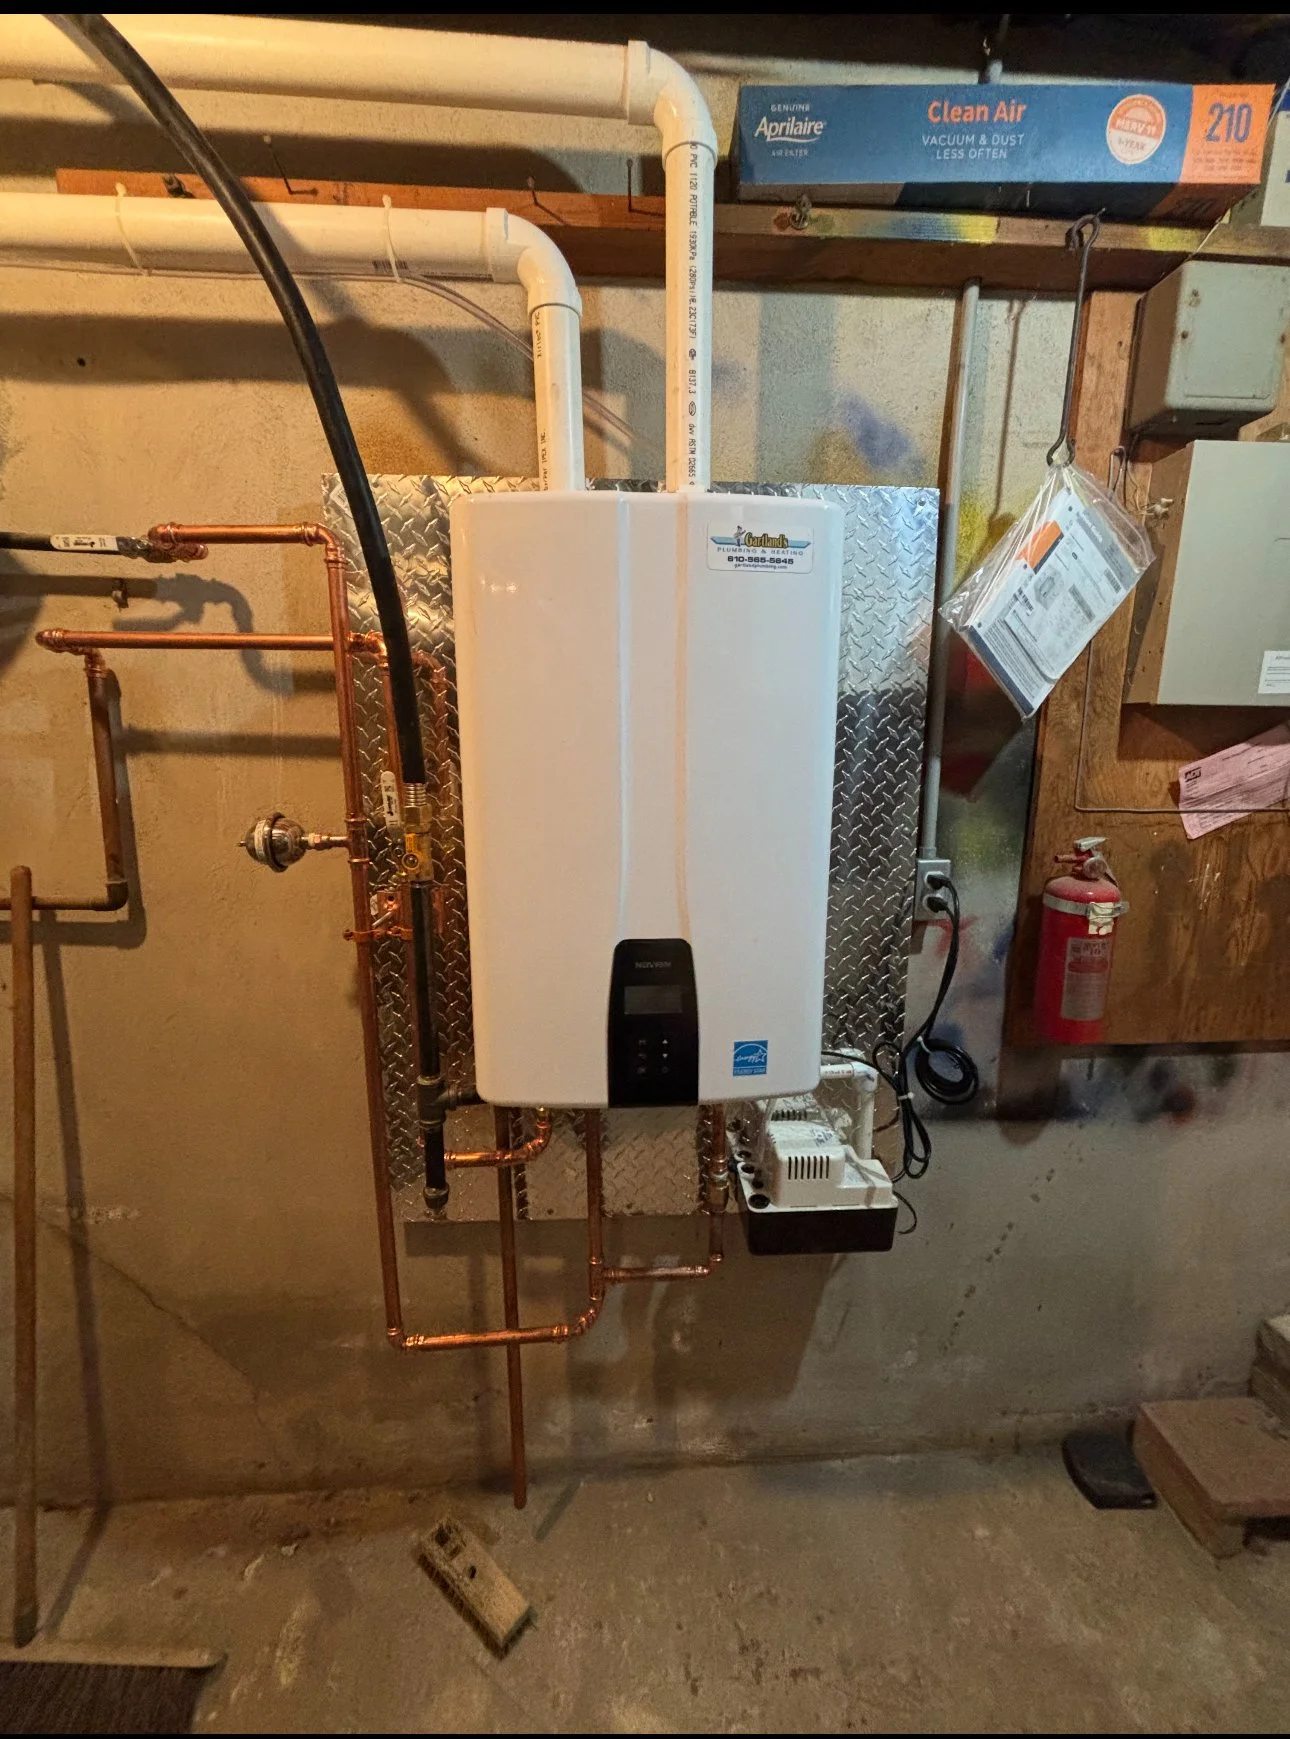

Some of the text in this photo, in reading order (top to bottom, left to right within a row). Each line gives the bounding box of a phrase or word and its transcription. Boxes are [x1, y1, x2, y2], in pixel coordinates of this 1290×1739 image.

[927, 99, 1027, 124] Clean Air
[1205, 102, 1252, 142] 210
[754, 115, 824, 143] Aprilaire
[921, 133, 1025, 146] VACUUM & DUST
[690, 153, 698, 168] PVC
[936, 148, 1008, 160] LESS OFTEN
[690, 172, 698, 191] 1120
[689, 194, 698, 226] POTABLE
